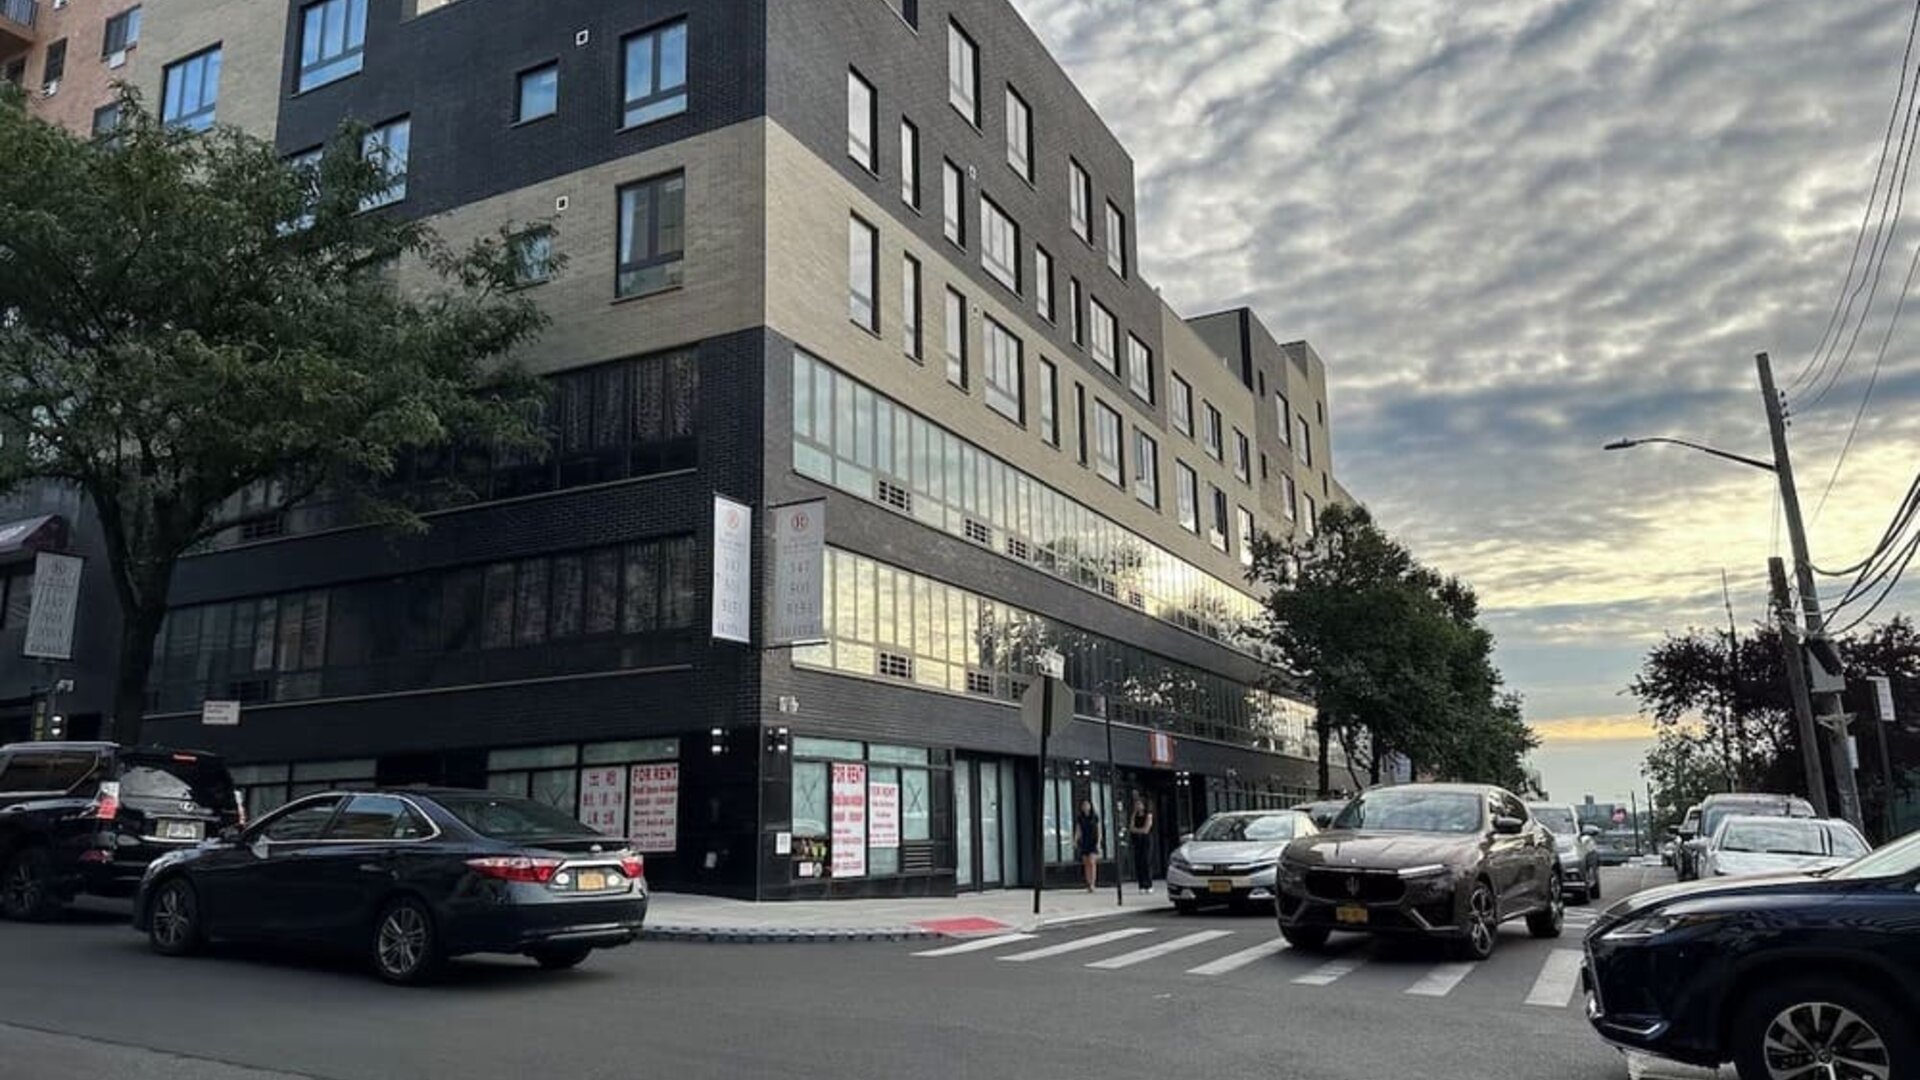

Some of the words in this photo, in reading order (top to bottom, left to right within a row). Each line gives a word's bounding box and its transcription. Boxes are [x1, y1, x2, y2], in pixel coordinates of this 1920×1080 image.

[633, 767, 652, 782] FOR
[654, 766, 677, 781] RENT
[847, 766, 864, 784] RENT
